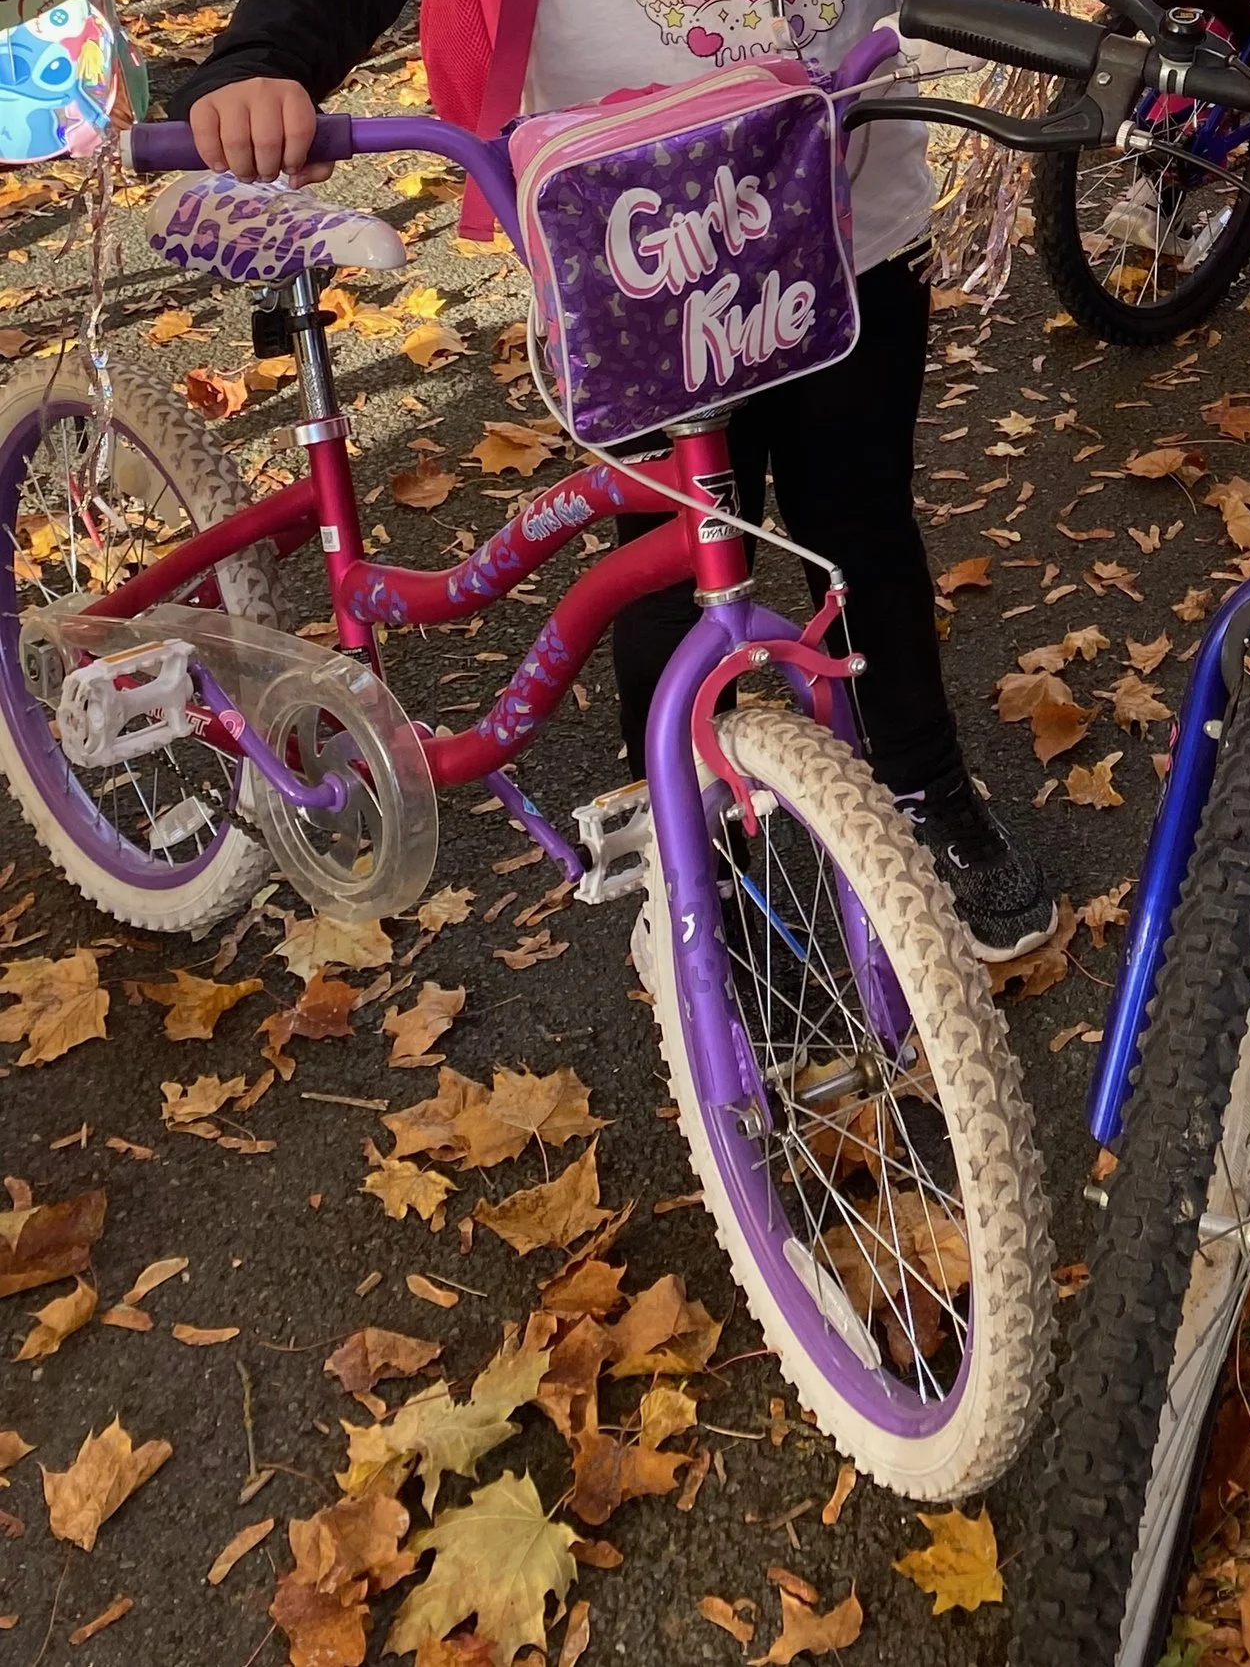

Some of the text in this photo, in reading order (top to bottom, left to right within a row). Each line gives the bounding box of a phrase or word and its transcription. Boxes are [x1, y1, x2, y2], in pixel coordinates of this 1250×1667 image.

[606, 165, 771, 299] Girls
[681, 269, 816, 392] Rule
[521, 490, 596, 543] Girls Rule
